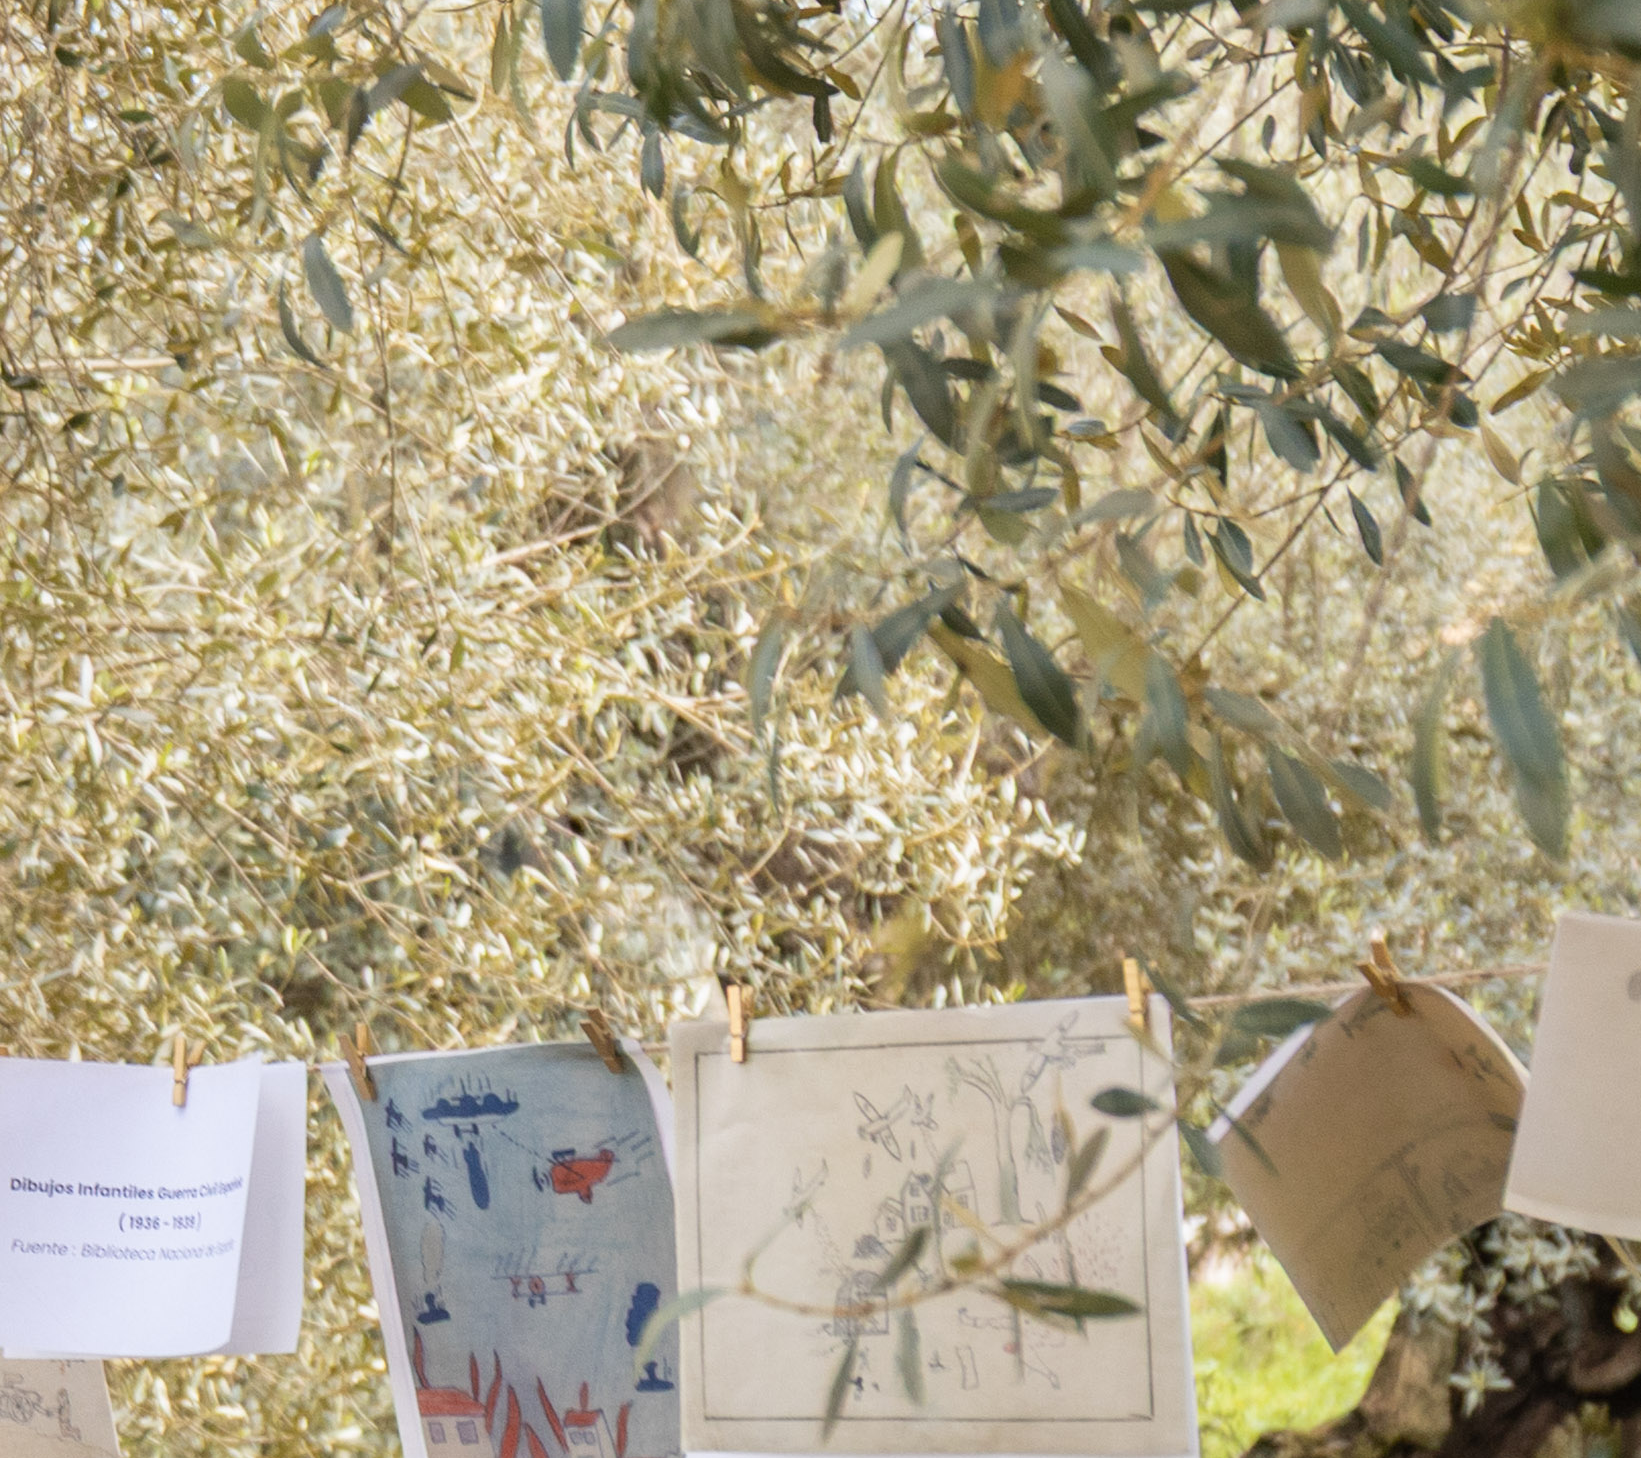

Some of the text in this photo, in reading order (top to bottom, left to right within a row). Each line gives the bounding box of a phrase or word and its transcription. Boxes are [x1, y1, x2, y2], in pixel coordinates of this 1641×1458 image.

[10, 1177, 75, 1198] Dibujos
[78, 1182, 154, 1200] Infantiles
[129, 1216, 160, 1231] 1936
[81, 1243, 155, 1261] Biblioteca
